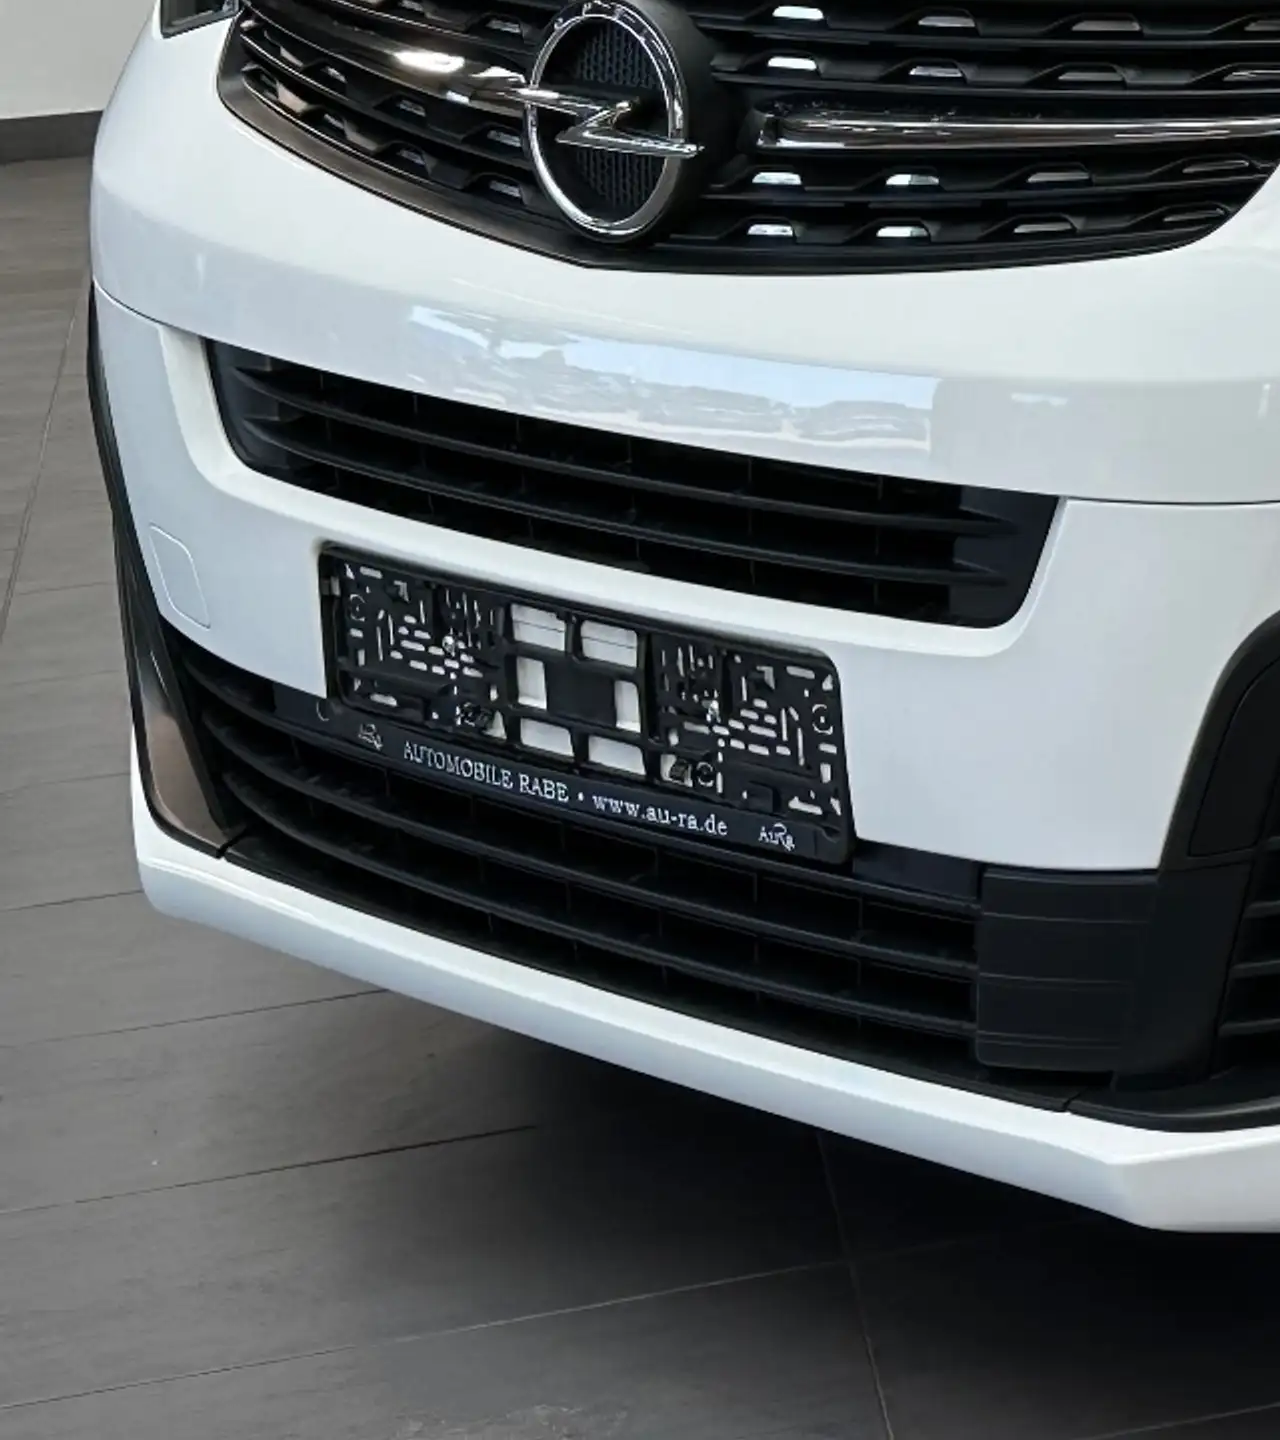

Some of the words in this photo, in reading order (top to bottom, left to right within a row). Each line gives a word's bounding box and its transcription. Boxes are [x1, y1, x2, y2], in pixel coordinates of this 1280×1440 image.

[403, 740, 514, 790] AUTOMOBILE
[518, 772, 570, 803] RABE
[592, 794, 729, 837] www.au-ra.de
